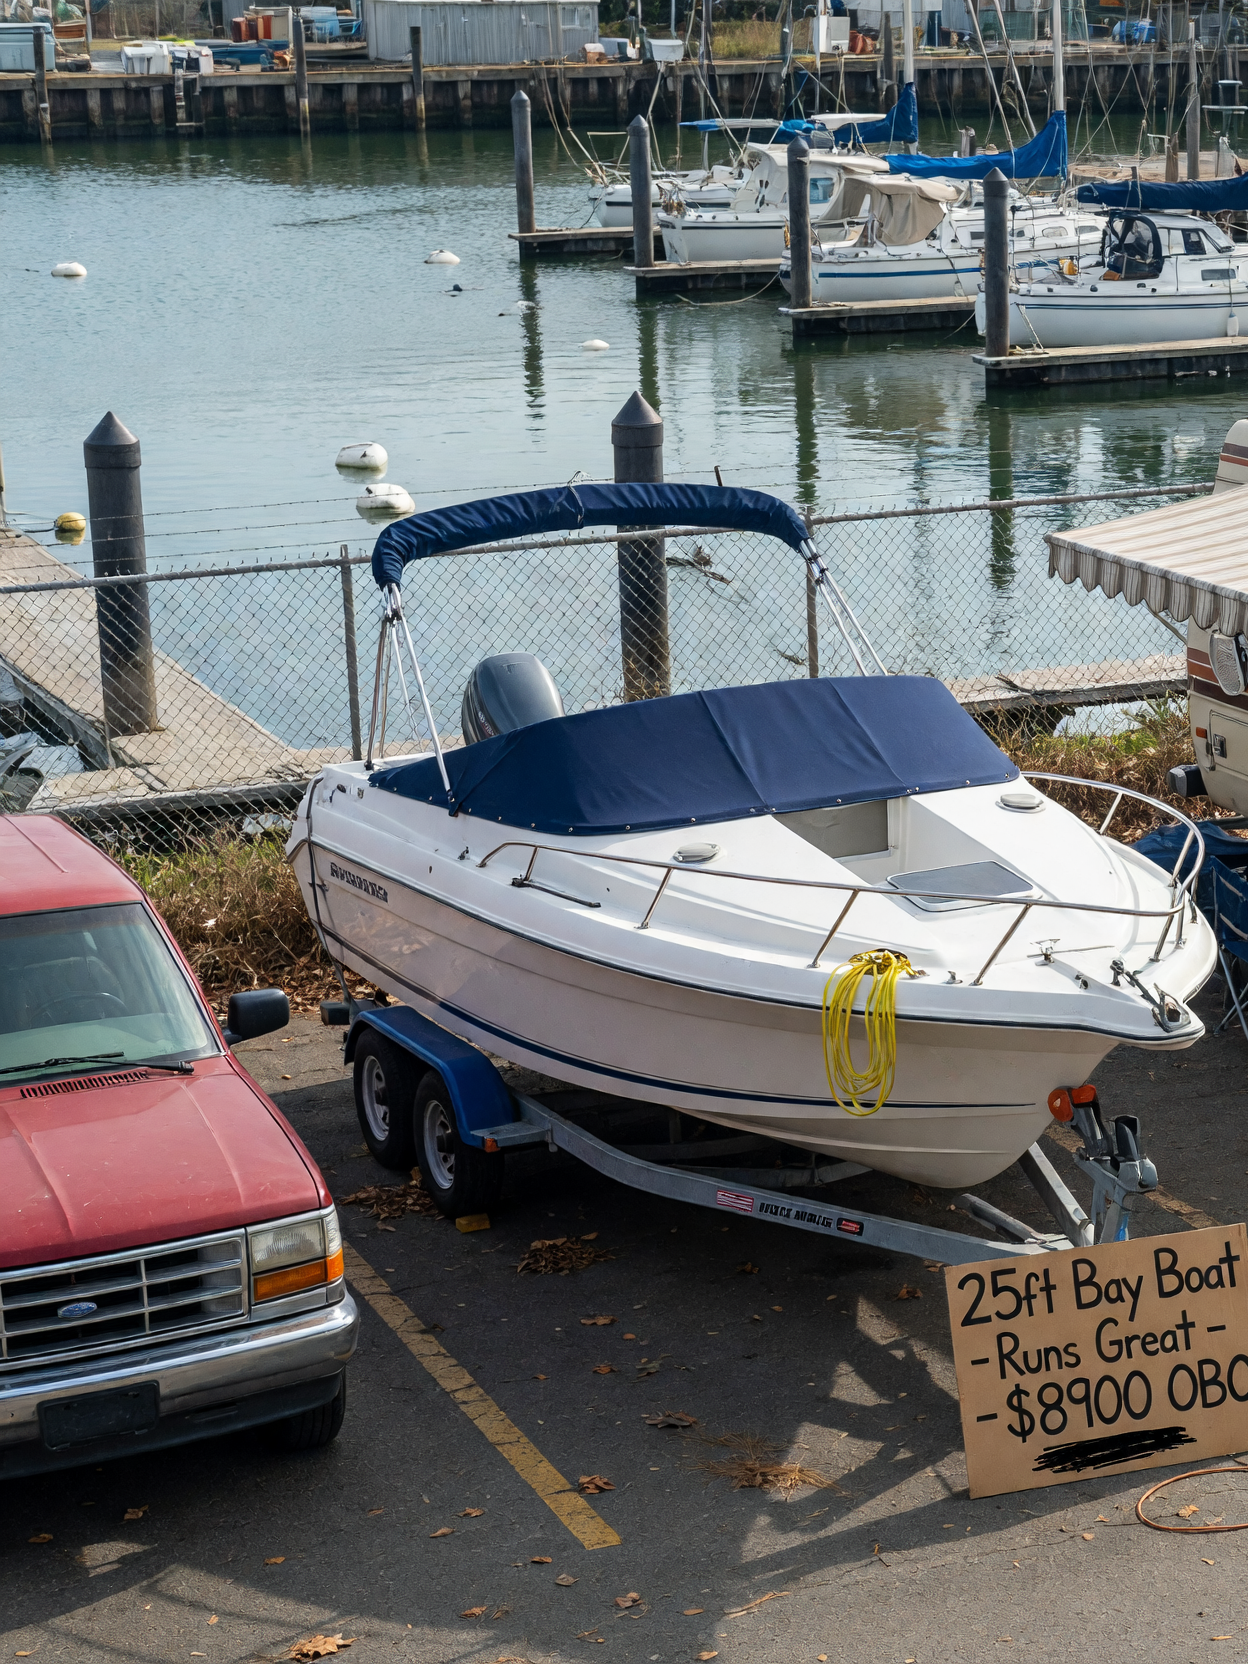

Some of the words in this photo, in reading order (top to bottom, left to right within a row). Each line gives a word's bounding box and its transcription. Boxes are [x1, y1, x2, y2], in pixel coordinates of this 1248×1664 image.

[957, 1267, 1058, 1328] 25ft
[1071, 1258, 1144, 1322] Bay
[1153, 1240, 1241, 1300] Boat
